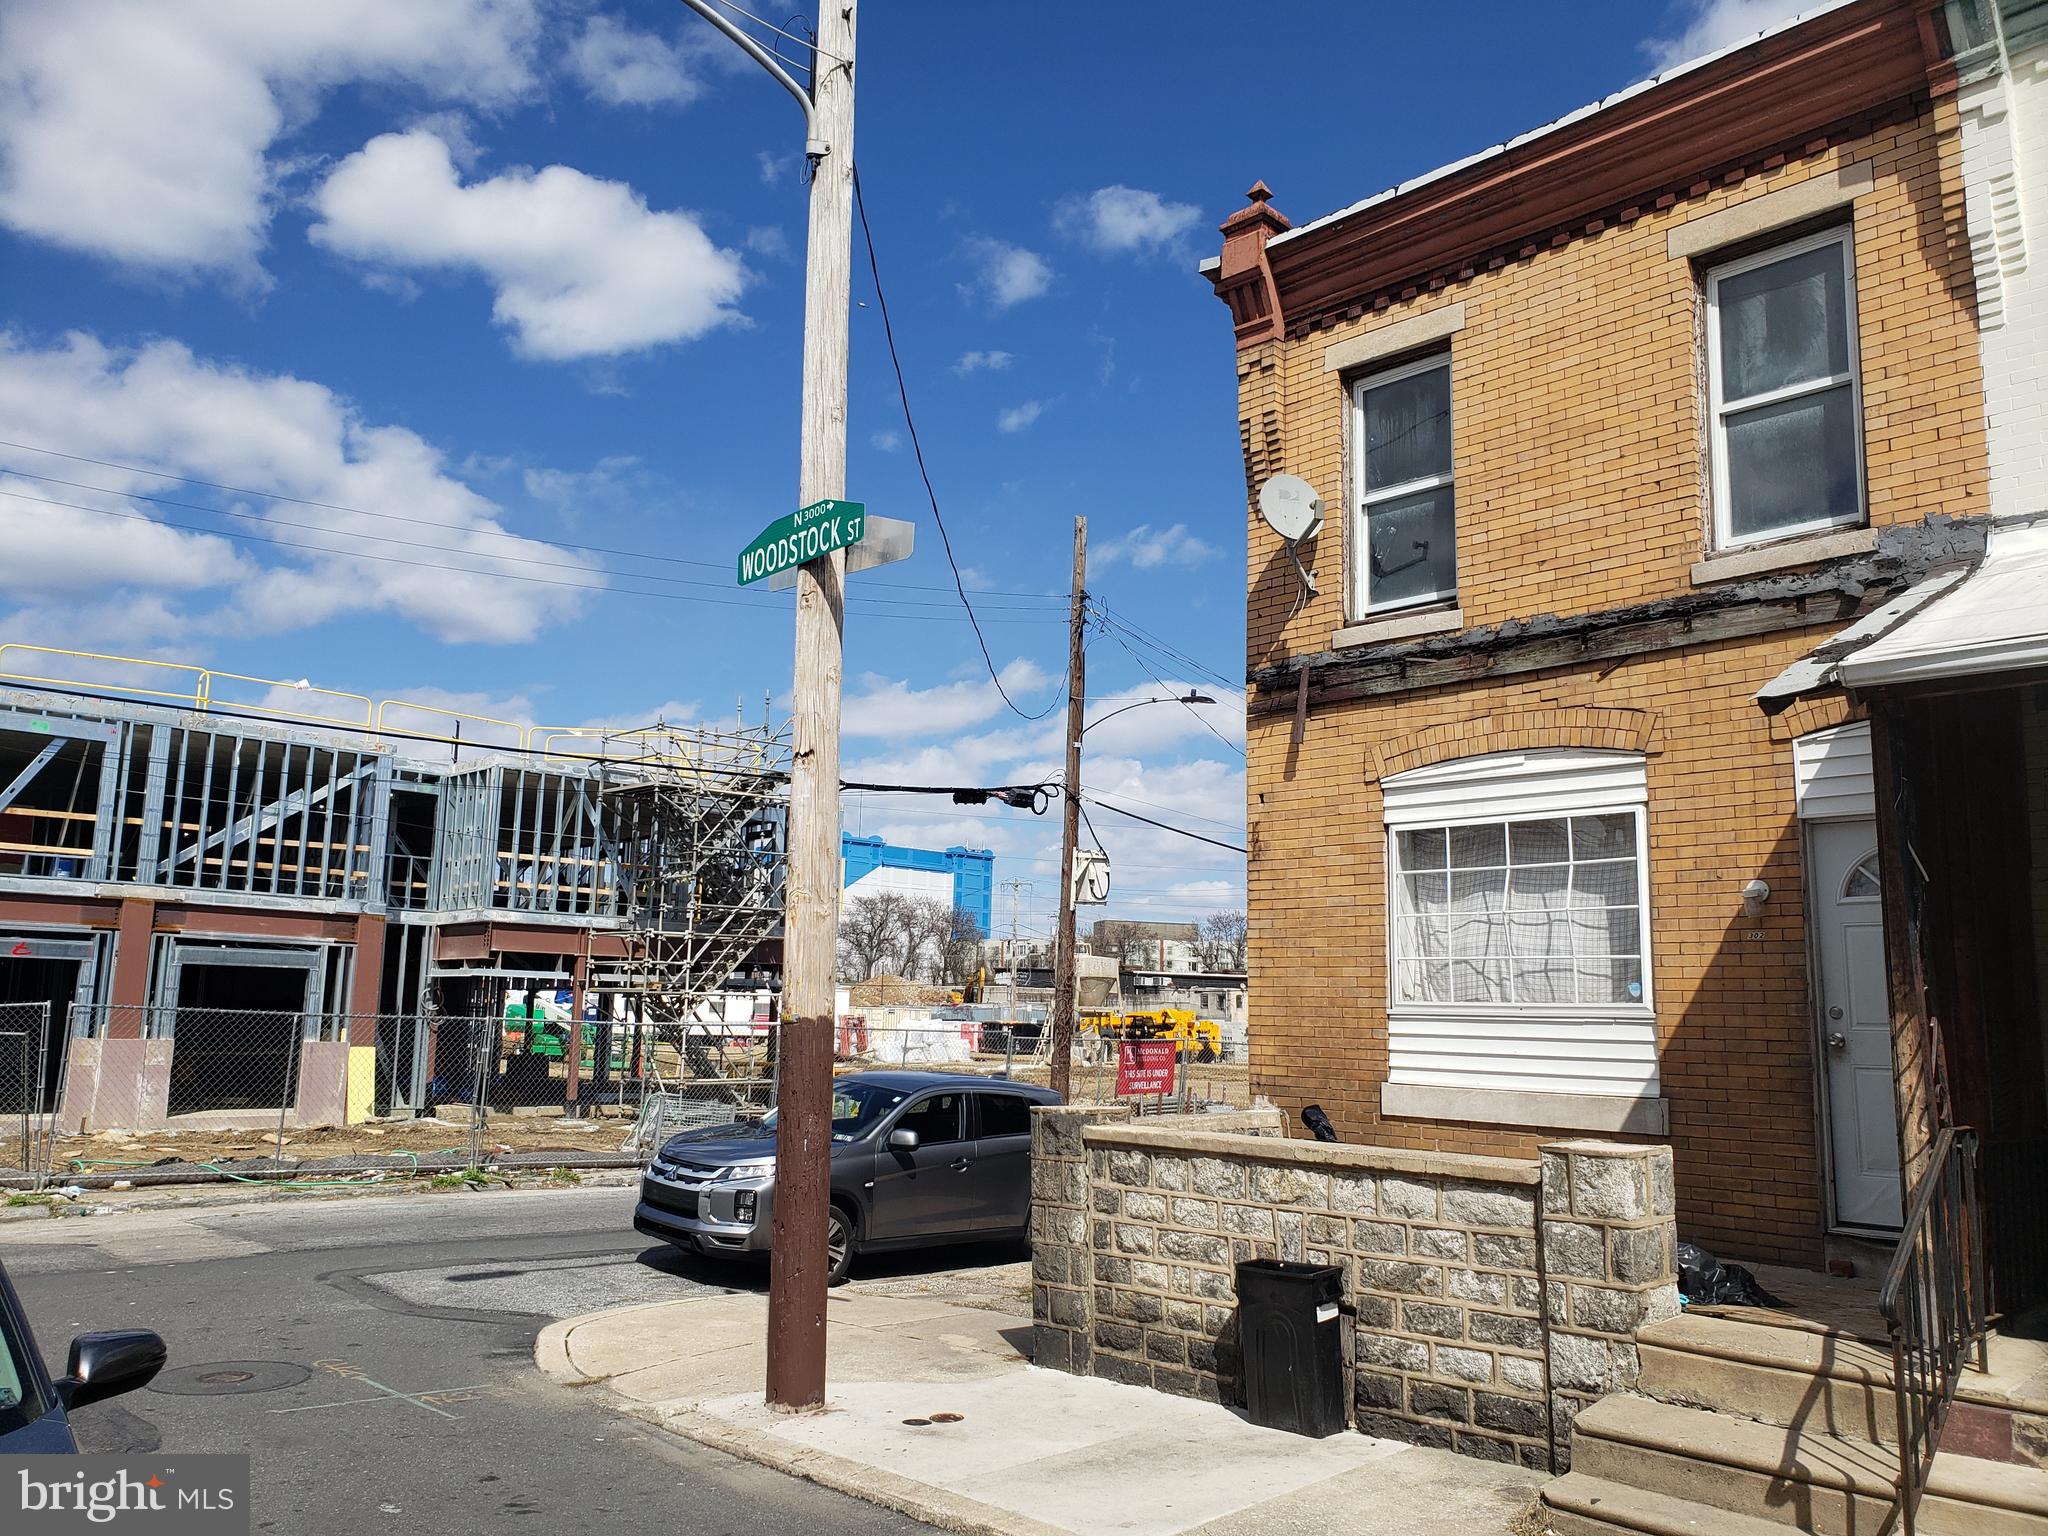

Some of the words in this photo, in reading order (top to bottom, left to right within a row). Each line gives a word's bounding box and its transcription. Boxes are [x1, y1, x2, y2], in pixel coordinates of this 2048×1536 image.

[794, 511, 802, 528] N
[803, 503, 826, 522] 3000
[742, 516, 841, 581] WOODSTOCK
[847, 518, 861, 541] ST
[1124, 1070, 1136, 1079] THIS
[1136, 1069, 1147, 1078] SITE
[1147, 1069, 1152, 1078] IS
[1152, 1069, 1169, 1078] UNDER
[1129, 1080, 1163, 1090] SURVEILLANCE
